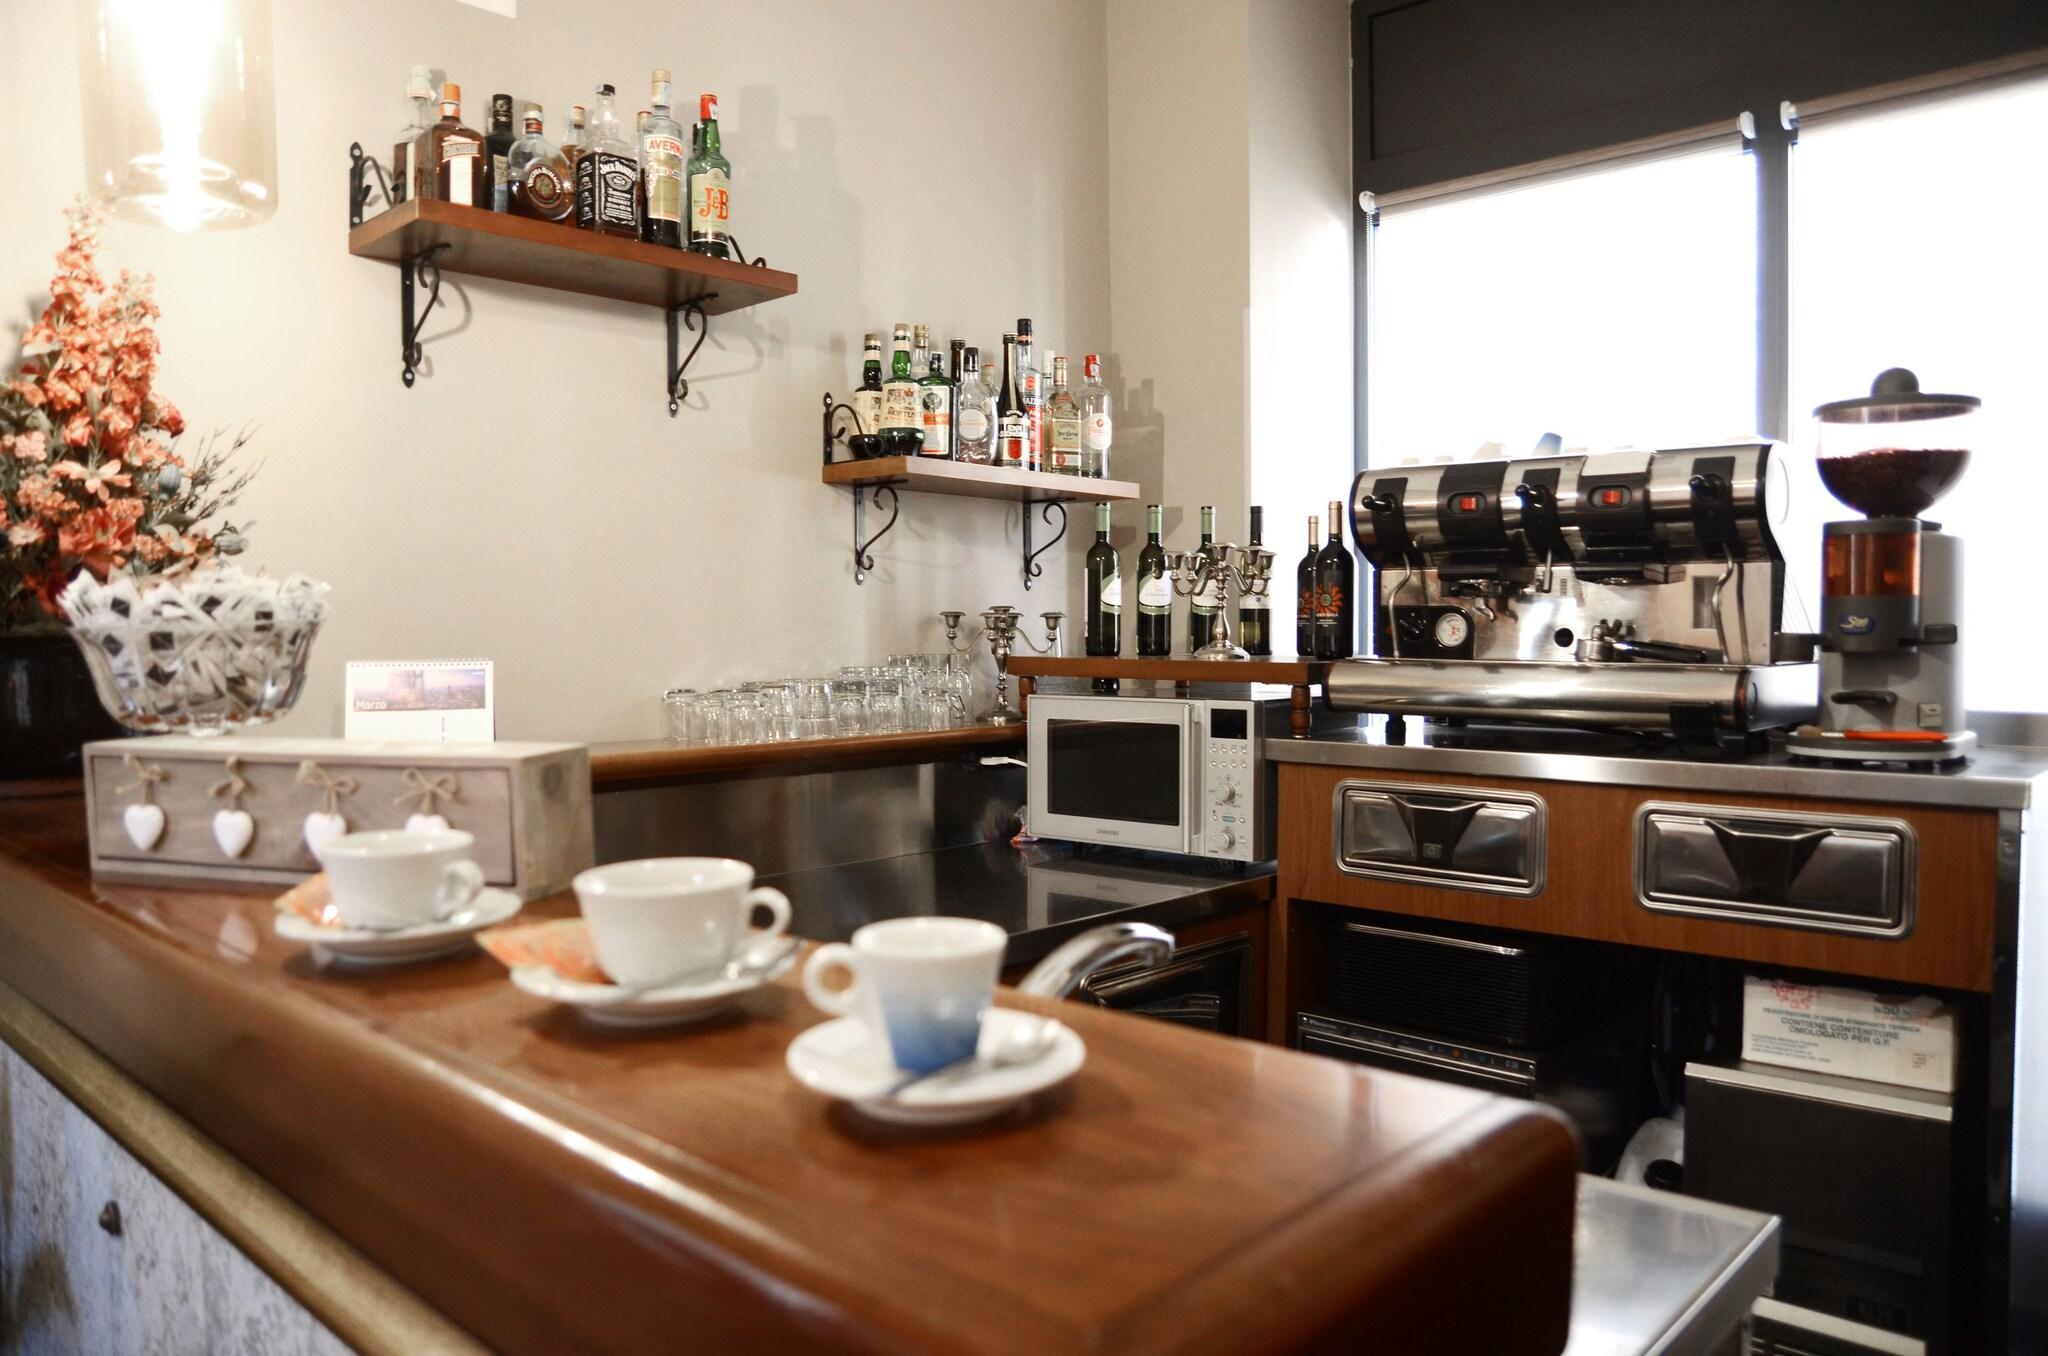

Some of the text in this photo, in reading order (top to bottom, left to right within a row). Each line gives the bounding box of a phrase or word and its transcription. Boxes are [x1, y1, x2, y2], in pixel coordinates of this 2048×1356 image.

[648, 138, 684, 157] AVERN
[356, 699, 387, 709] Marzo
[1780, 1017, 1900, 1041] CONTIENE CONTENITORE
[1788, 1025, 1849, 1040] OMOLOGATO
[1851, 1033, 1871, 1044] PER
